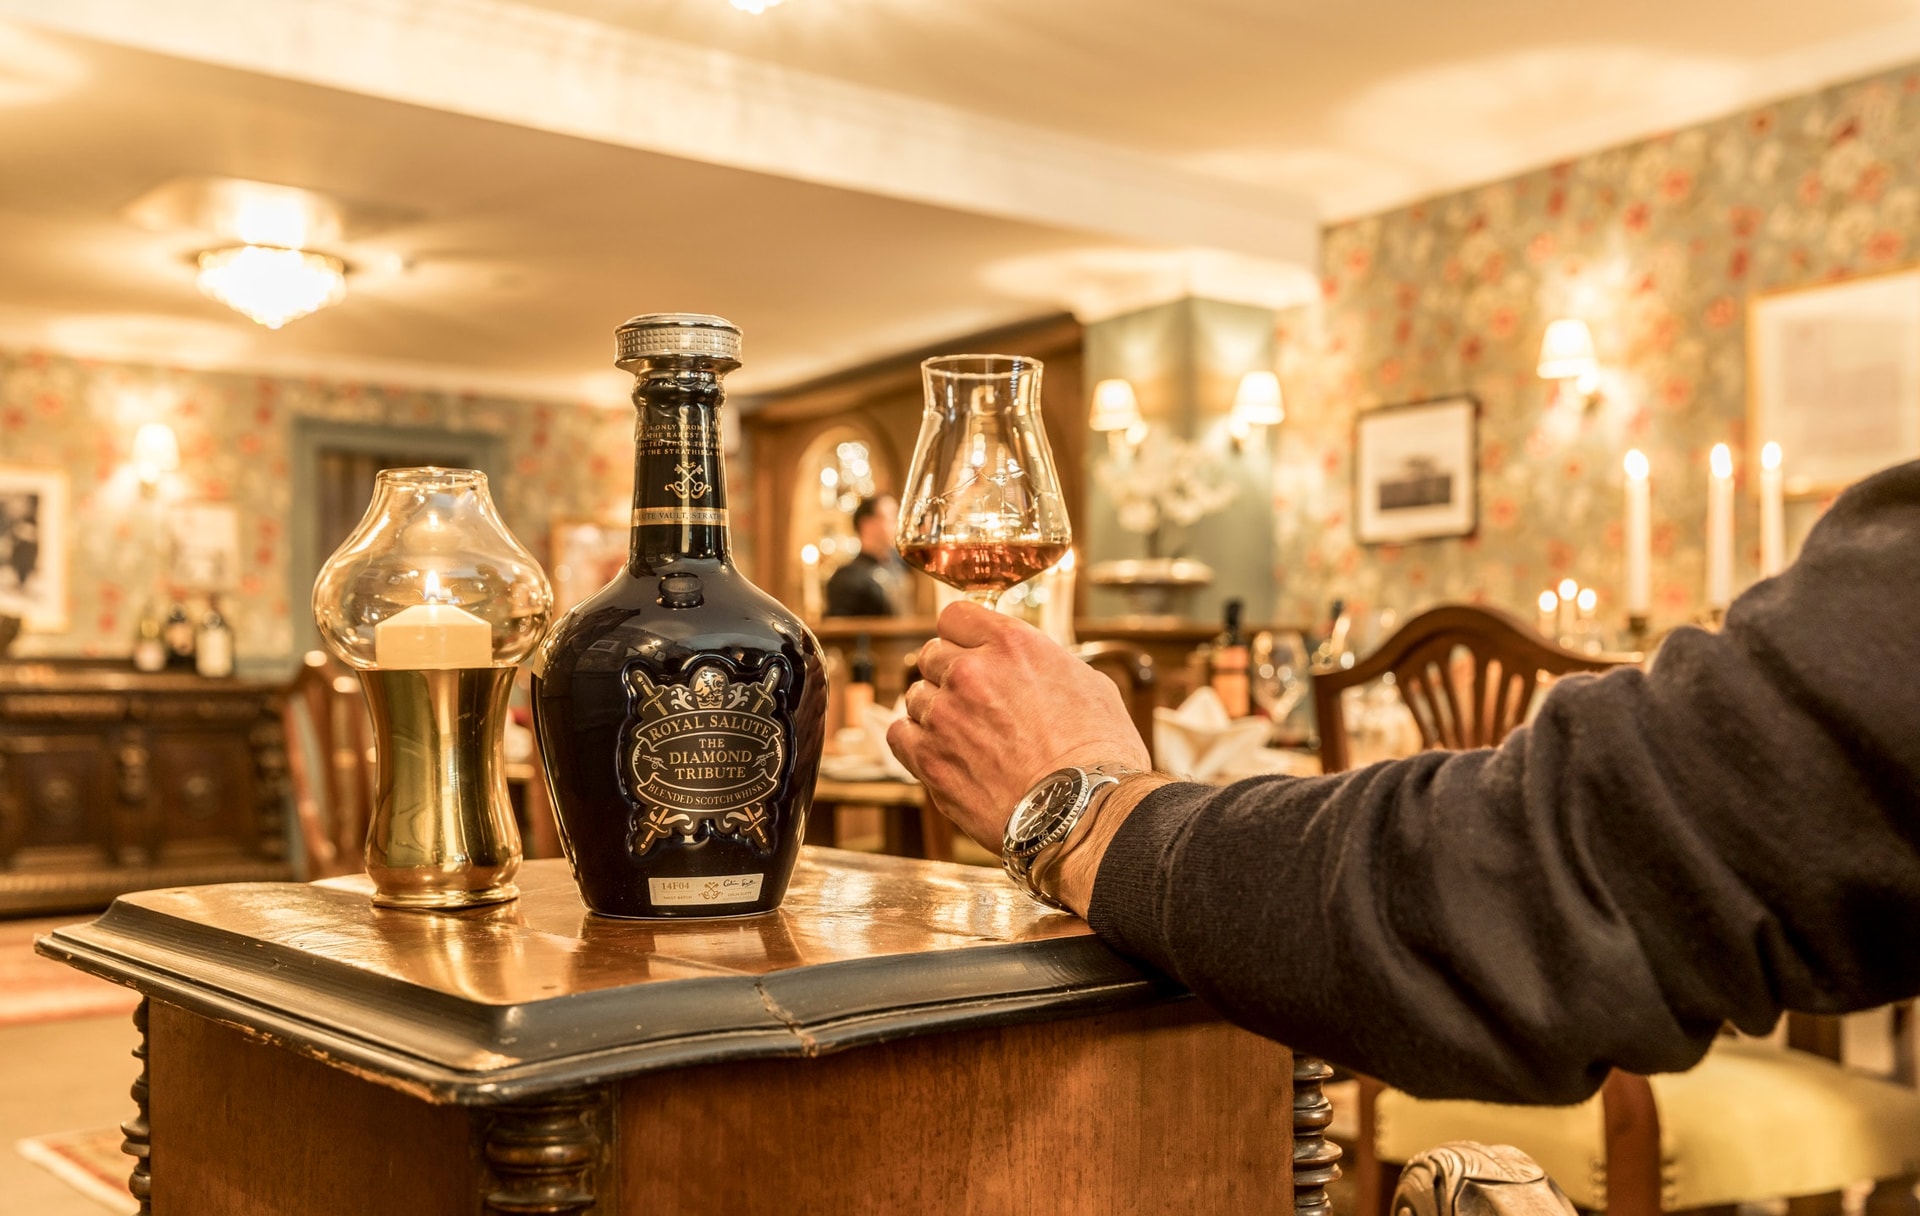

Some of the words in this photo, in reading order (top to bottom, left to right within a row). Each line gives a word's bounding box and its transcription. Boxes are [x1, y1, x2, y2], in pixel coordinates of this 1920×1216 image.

[648, 448, 661, 456] THE
[649, 716, 705, 741] ROYAL
[710, 715, 771, 739] SALUTE
[699, 738, 725, 748] THE
[669, 751, 752, 765] DIAMOND
[674, 767, 746, 780] TRIBUTE
[648, 783, 694, 804] BLENDED
[695, 793, 733, 805] SCOTCH
[735, 781, 767, 799] WHISKY
[662, 882, 690, 890] 14F04
